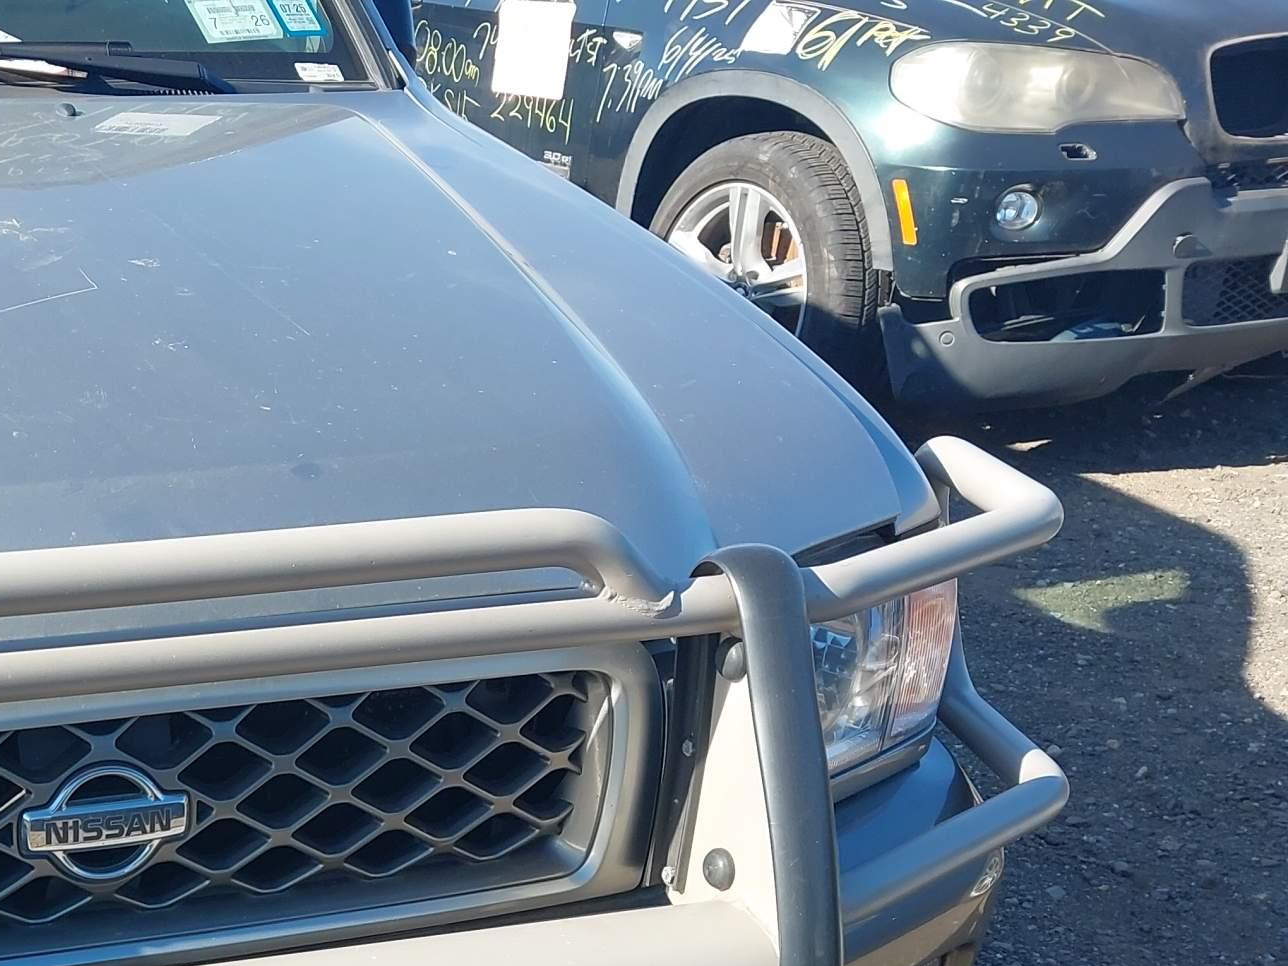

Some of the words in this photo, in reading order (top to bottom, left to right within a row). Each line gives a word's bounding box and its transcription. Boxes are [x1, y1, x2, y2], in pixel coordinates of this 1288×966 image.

[251, 14, 270, 27] 26
[982, 1, 1076, 43] 4339
[44, 808, 172, 846] NISSAN
